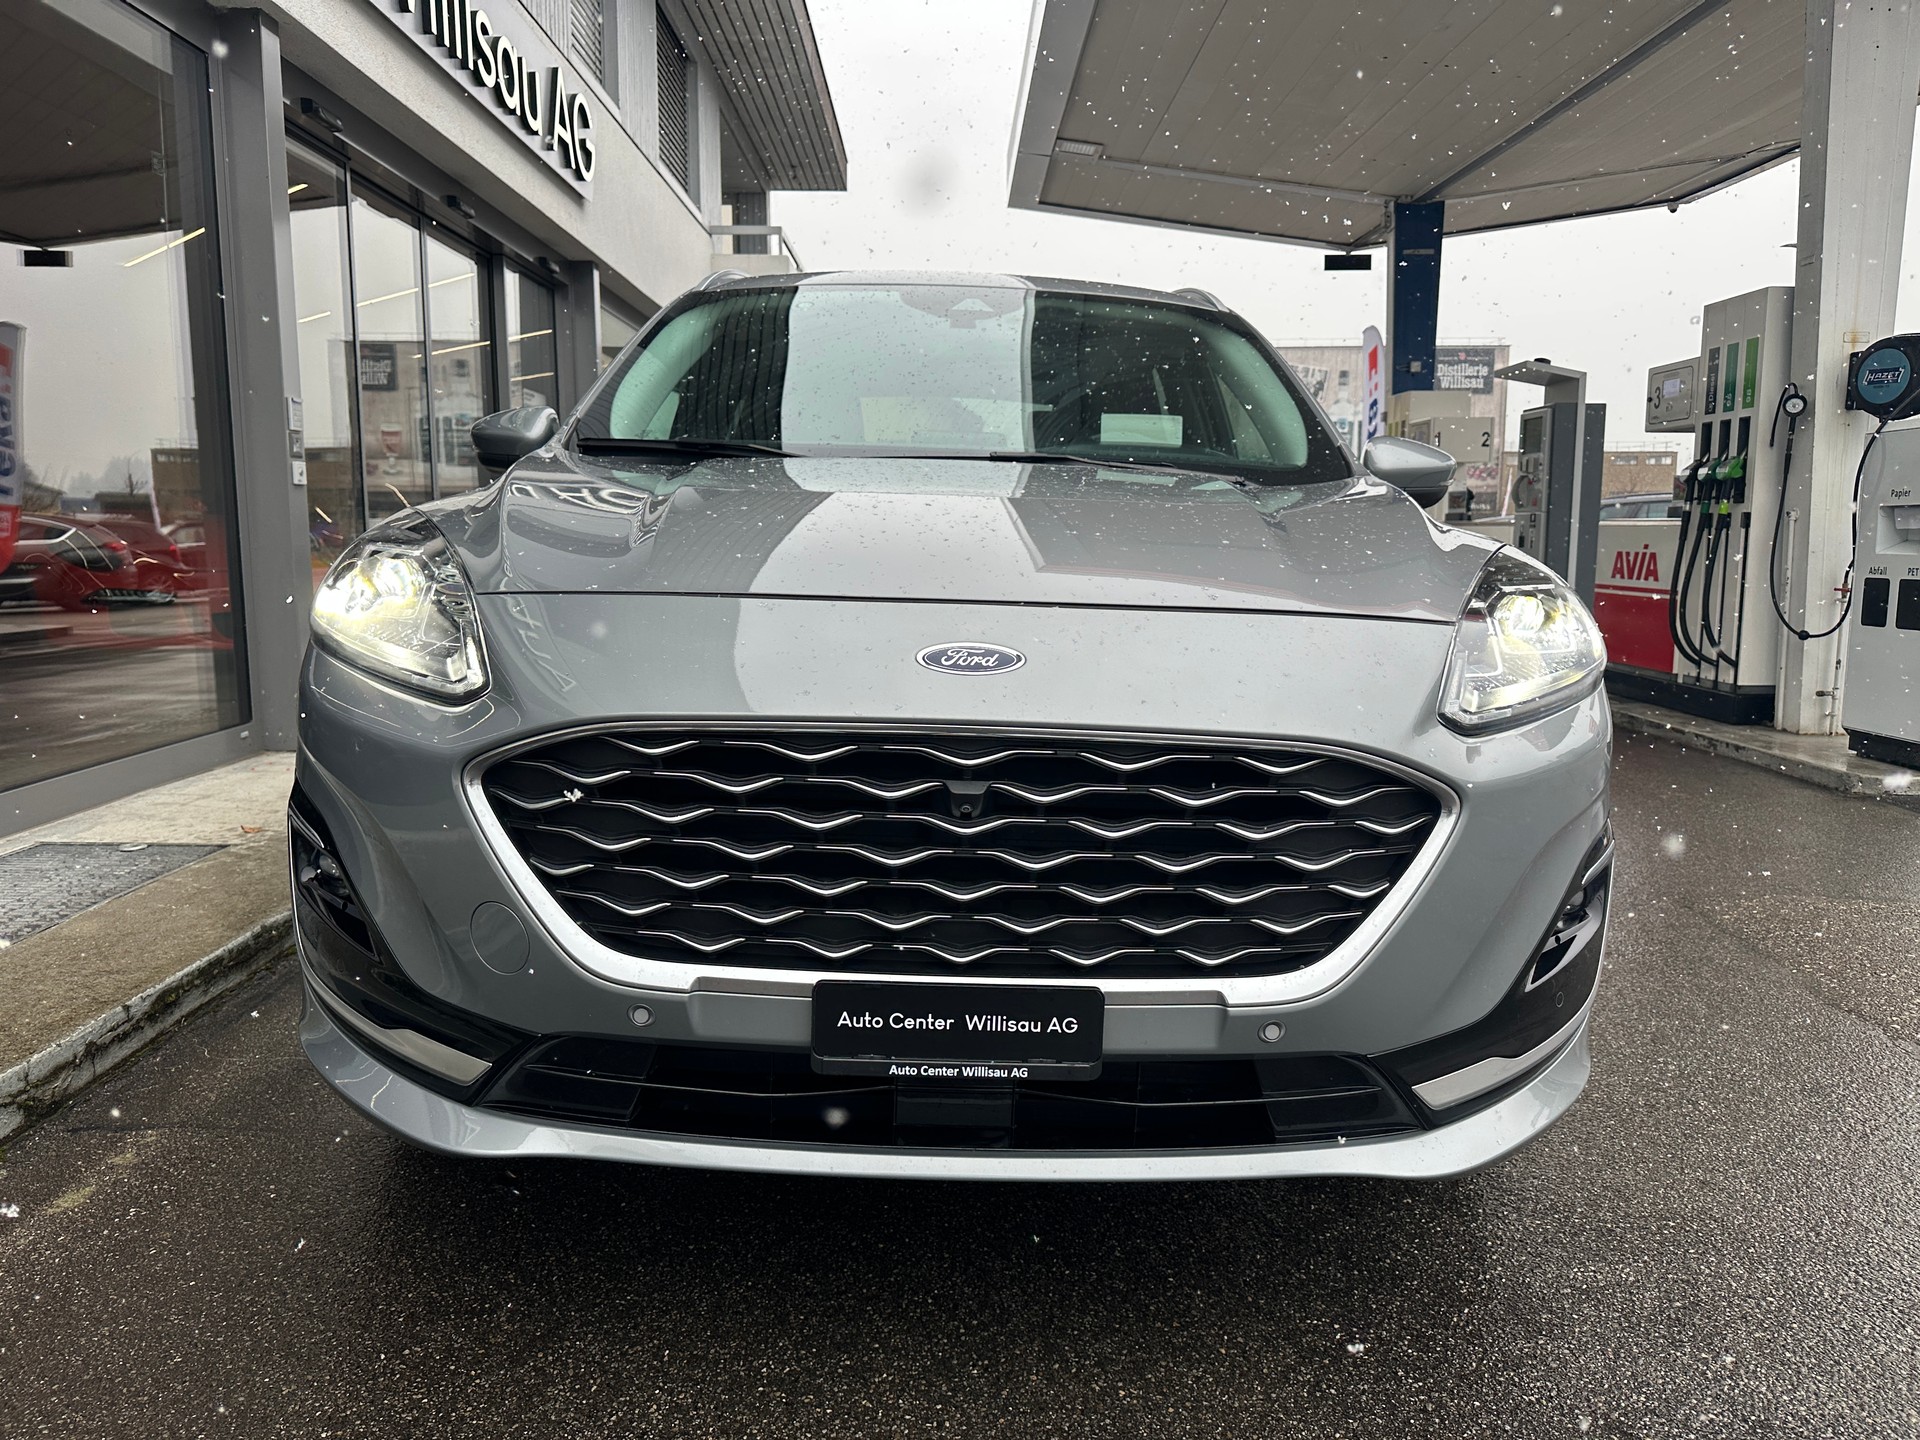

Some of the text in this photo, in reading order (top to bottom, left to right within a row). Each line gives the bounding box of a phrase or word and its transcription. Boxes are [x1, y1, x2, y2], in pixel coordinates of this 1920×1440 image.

[552, 66, 595, 182] AG
[1436, 363, 1489, 376] Distillerie
[1866, 371, 1900, 381] HAZET
[1439, 376, 1484, 389] Willisau
[1653, 386, 1661, 410] 3
[1481, 431, 1491, 448] 2
[1890, 488, 1911, 500] Papier
[1868, 566, 1888, 576] Abfall
[1907, 567, 1919, 576] PET
[941, 648, 1000, 667] Ford
[837, 1010, 1079, 1034] Auto Center Willisau AG
[889, 1064, 1029, 1079] Auto Center Willisau AG
